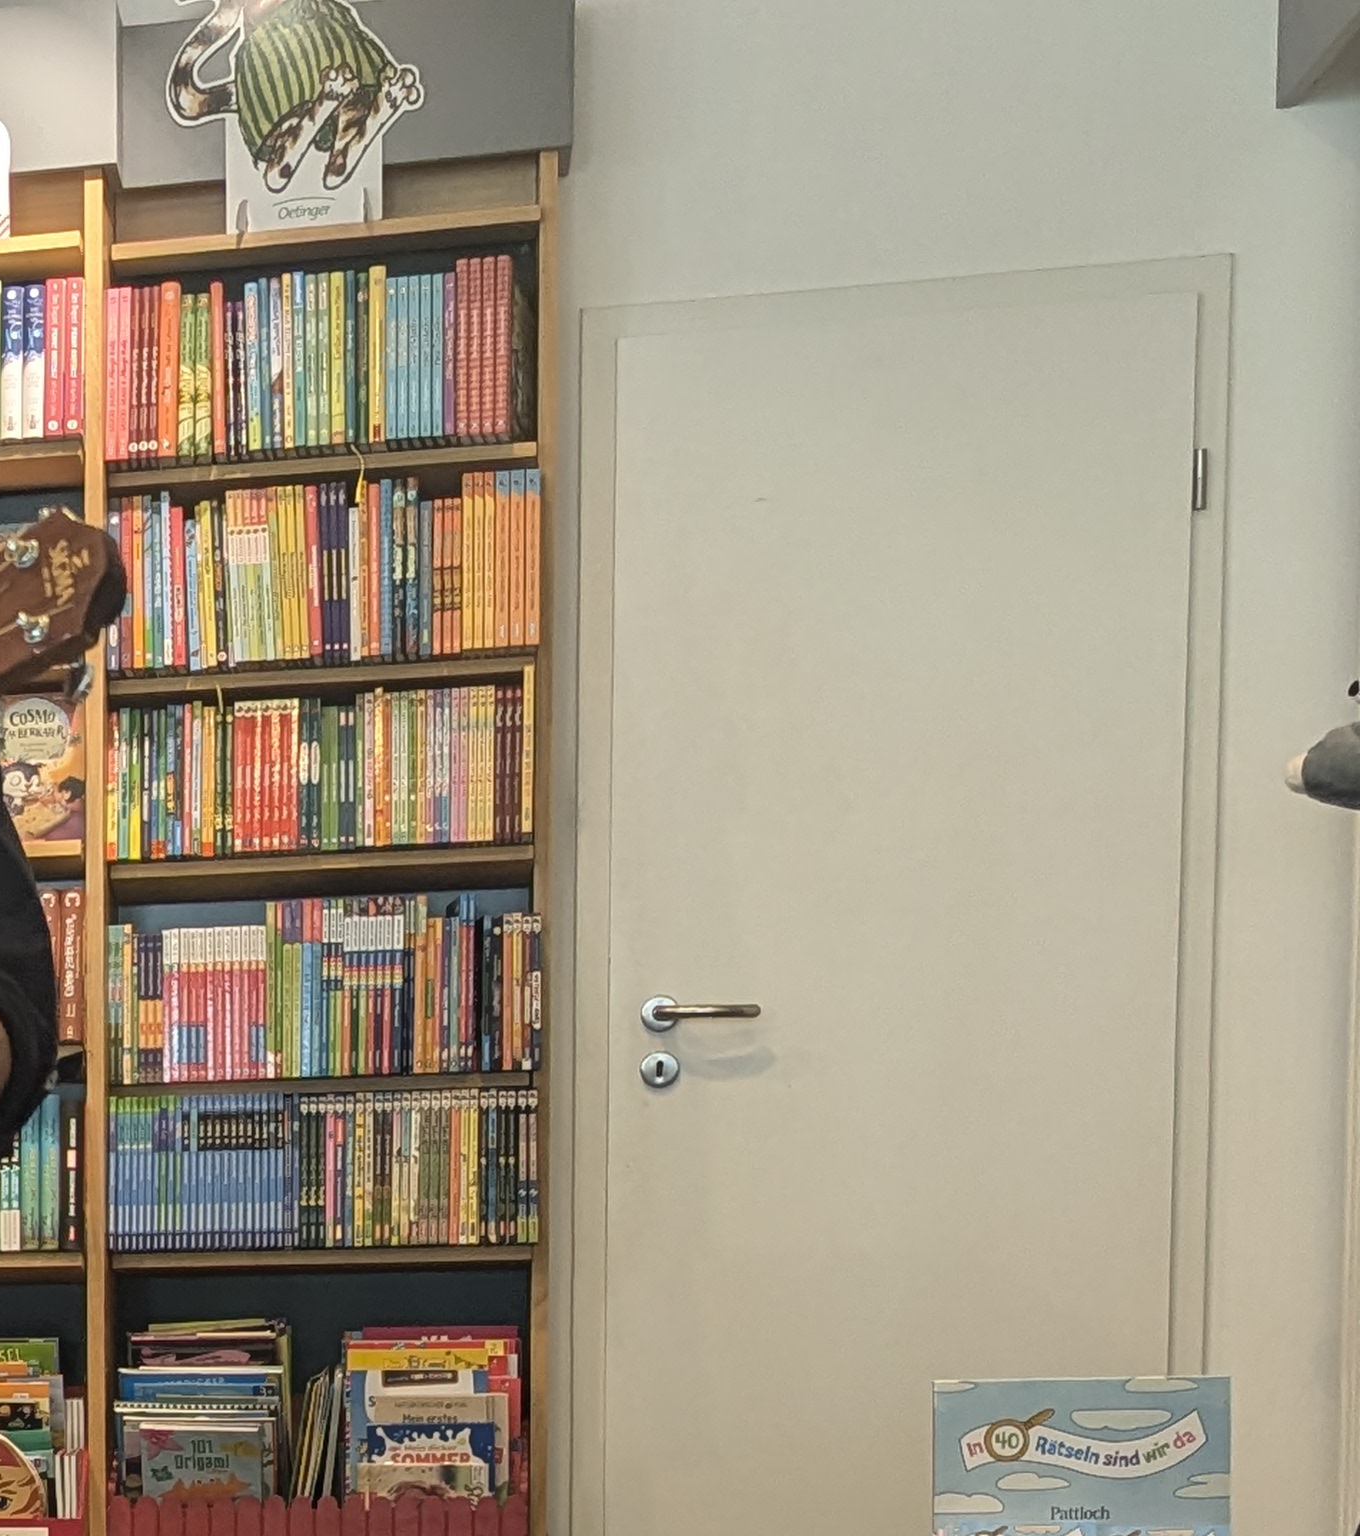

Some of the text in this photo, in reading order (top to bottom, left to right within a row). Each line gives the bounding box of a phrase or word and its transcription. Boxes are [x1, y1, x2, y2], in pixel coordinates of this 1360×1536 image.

[278, 204, 331, 221] Oetinger
[9, 708, 56, 728] COSMO
[191, 1440, 214, 1453] 101
[966, 1429, 1197, 1468] In 40 Rätseln sind wir da
[174, 1454, 230, 1471] Origami
[390, 1452, 471, 1464] SOMMER
[1050, 1506, 1111, 1522] Pattloch
